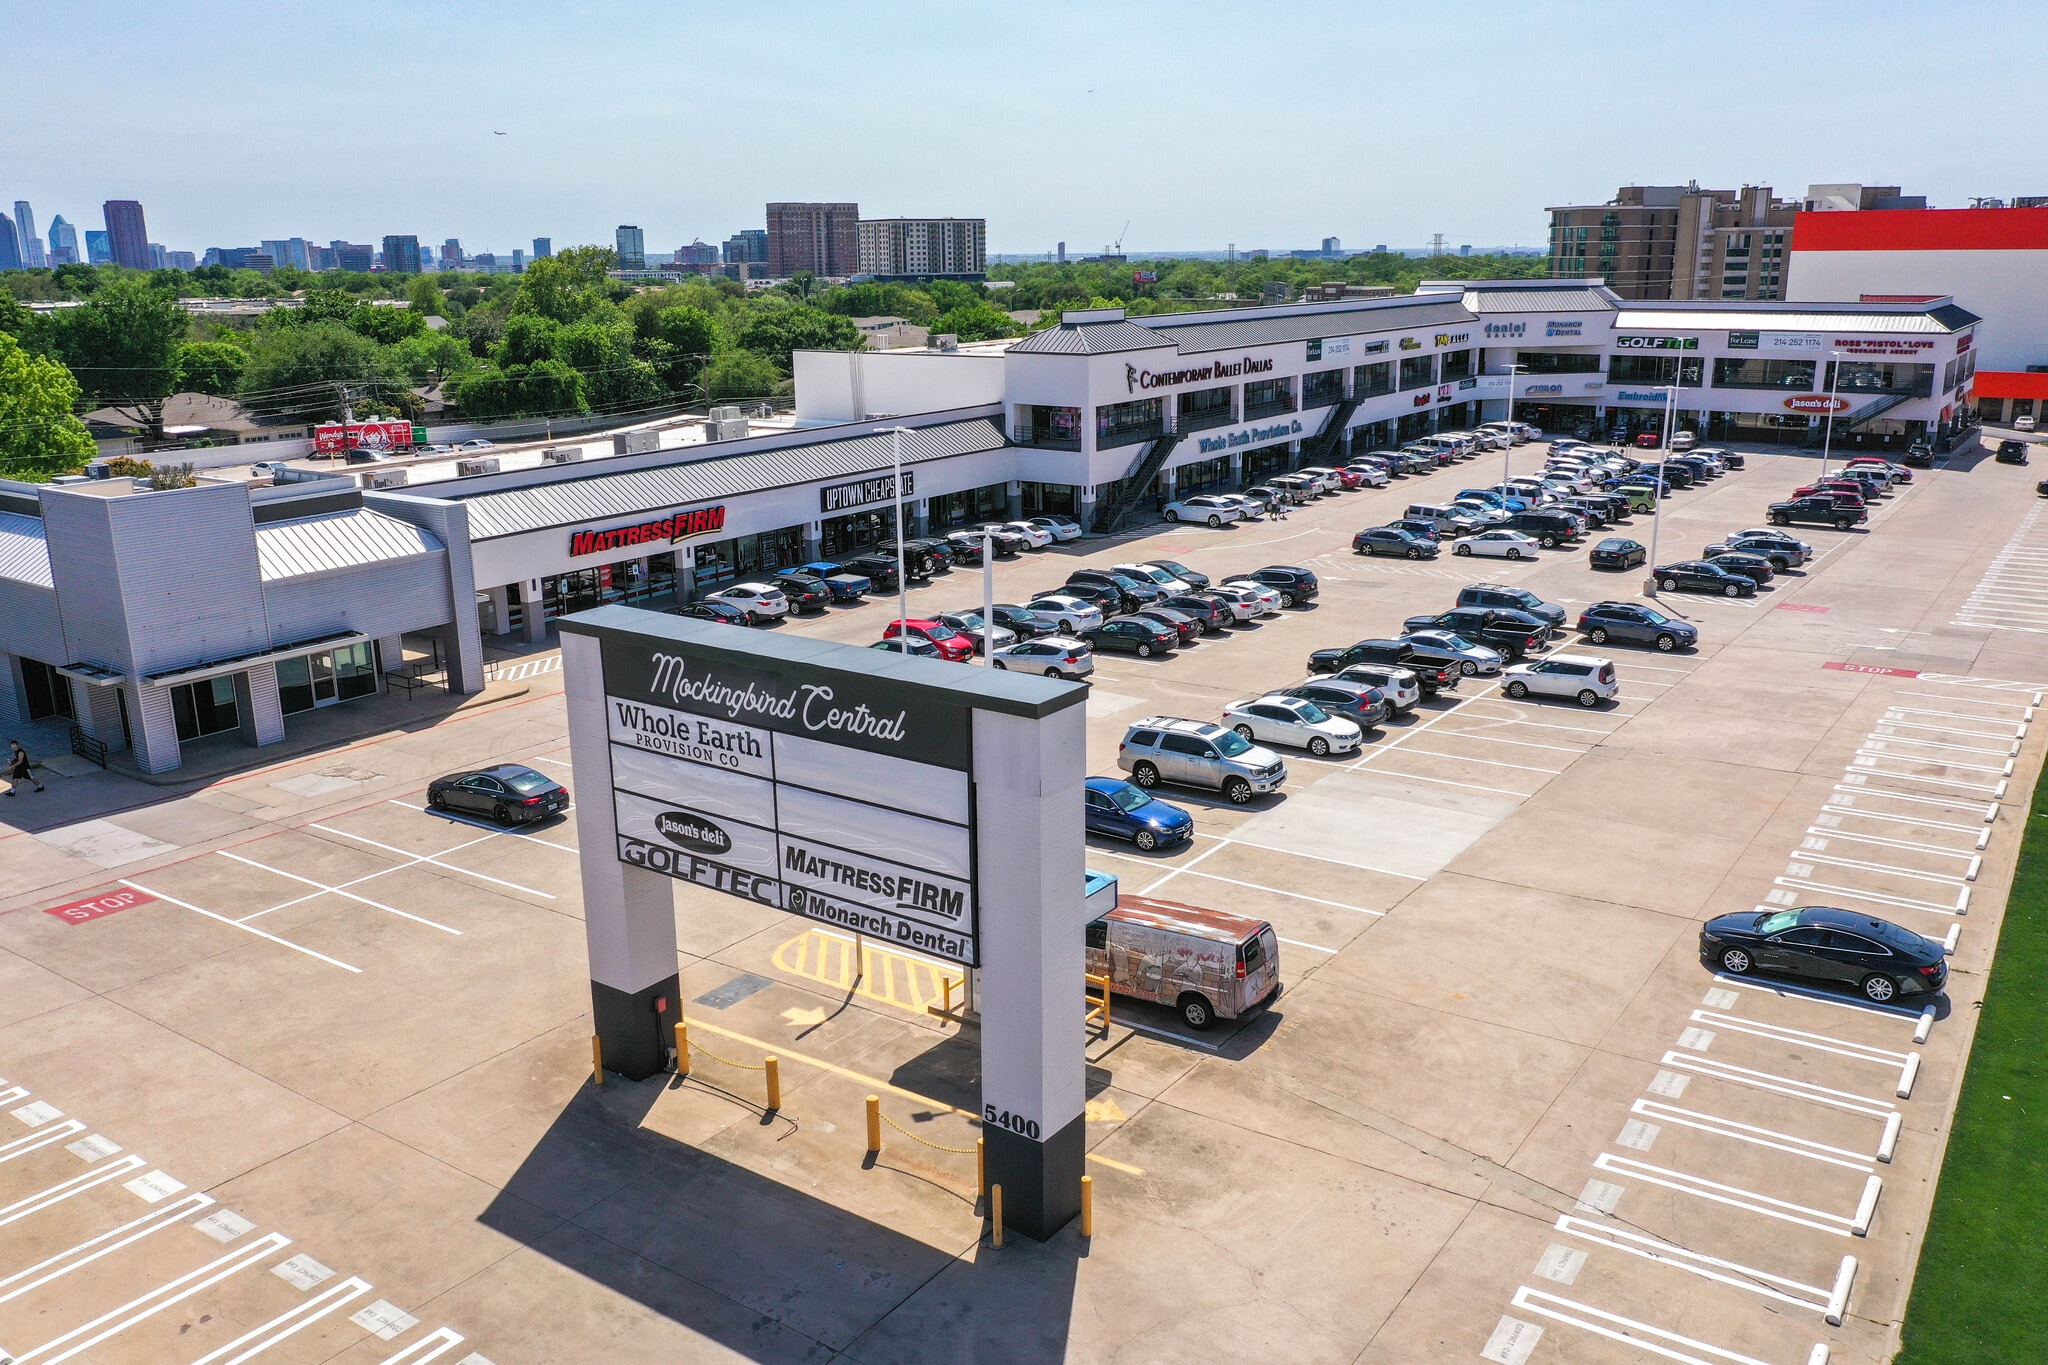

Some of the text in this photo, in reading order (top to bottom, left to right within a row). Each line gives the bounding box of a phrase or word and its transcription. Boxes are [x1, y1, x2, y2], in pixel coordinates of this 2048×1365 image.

[1140, 358, 1273, 389] CONTEMPORARY BALLET DALLAS
[1618, 391, 1675, 401] EmbroidM
[1791, 399, 1821, 408] Jason's
[1199, 436, 1226, 453] Whole
[1228, 431, 1250, 448] Earth
[1252, 424, 1290, 442] Provision
[827, 474, 912, 510] UPTOWN CHEAPSATE
[1844, 665, 1893, 674] STOP
[651, 652, 906, 741] Mockingbird Central
[615, 702, 763, 758] Whole Earth
[636, 733, 740, 768] PROVISION CO
[660, 815, 725, 847] Jason's deli
[624, 840, 774, 905] GOLFTEC
[63, 893, 135, 918] STOP
[809, 894, 965, 957] Monarch Dental
[985, 1104, 1040, 1139] 5400
